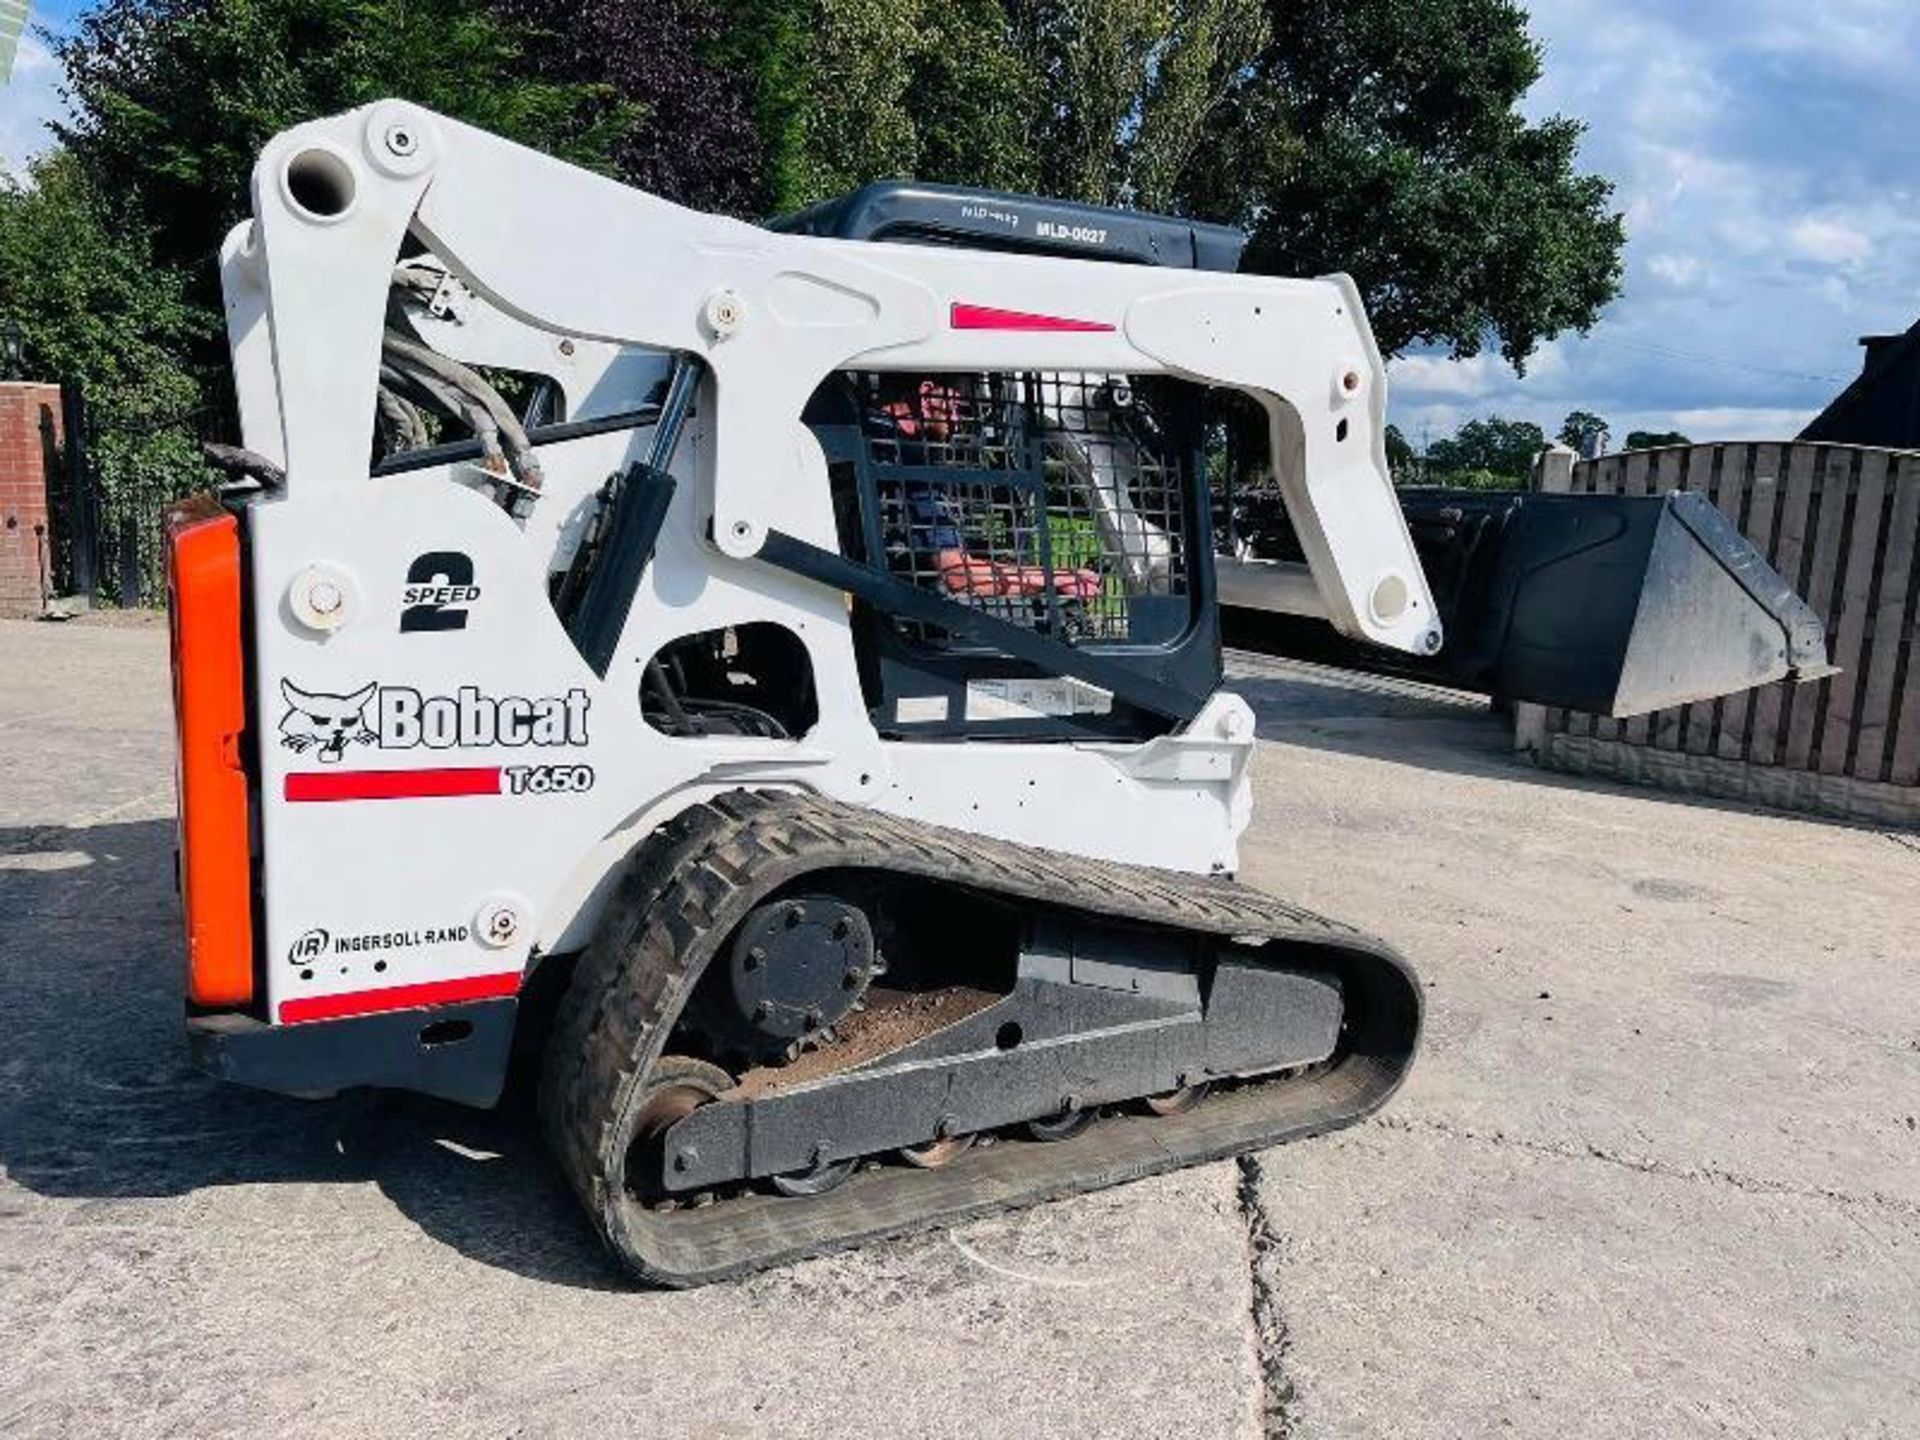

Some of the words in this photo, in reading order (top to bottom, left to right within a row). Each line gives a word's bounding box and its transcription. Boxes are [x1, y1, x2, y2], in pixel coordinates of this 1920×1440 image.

[1036, 221, 1107, 243] MLD-0027
[400, 551, 473, 632] 2
[402, 587, 480, 603] SPEED
[379, 686, 591, 749] Bobcat
[506, 766, 594, 795] T650
[297, 938, 319, 956] IR
